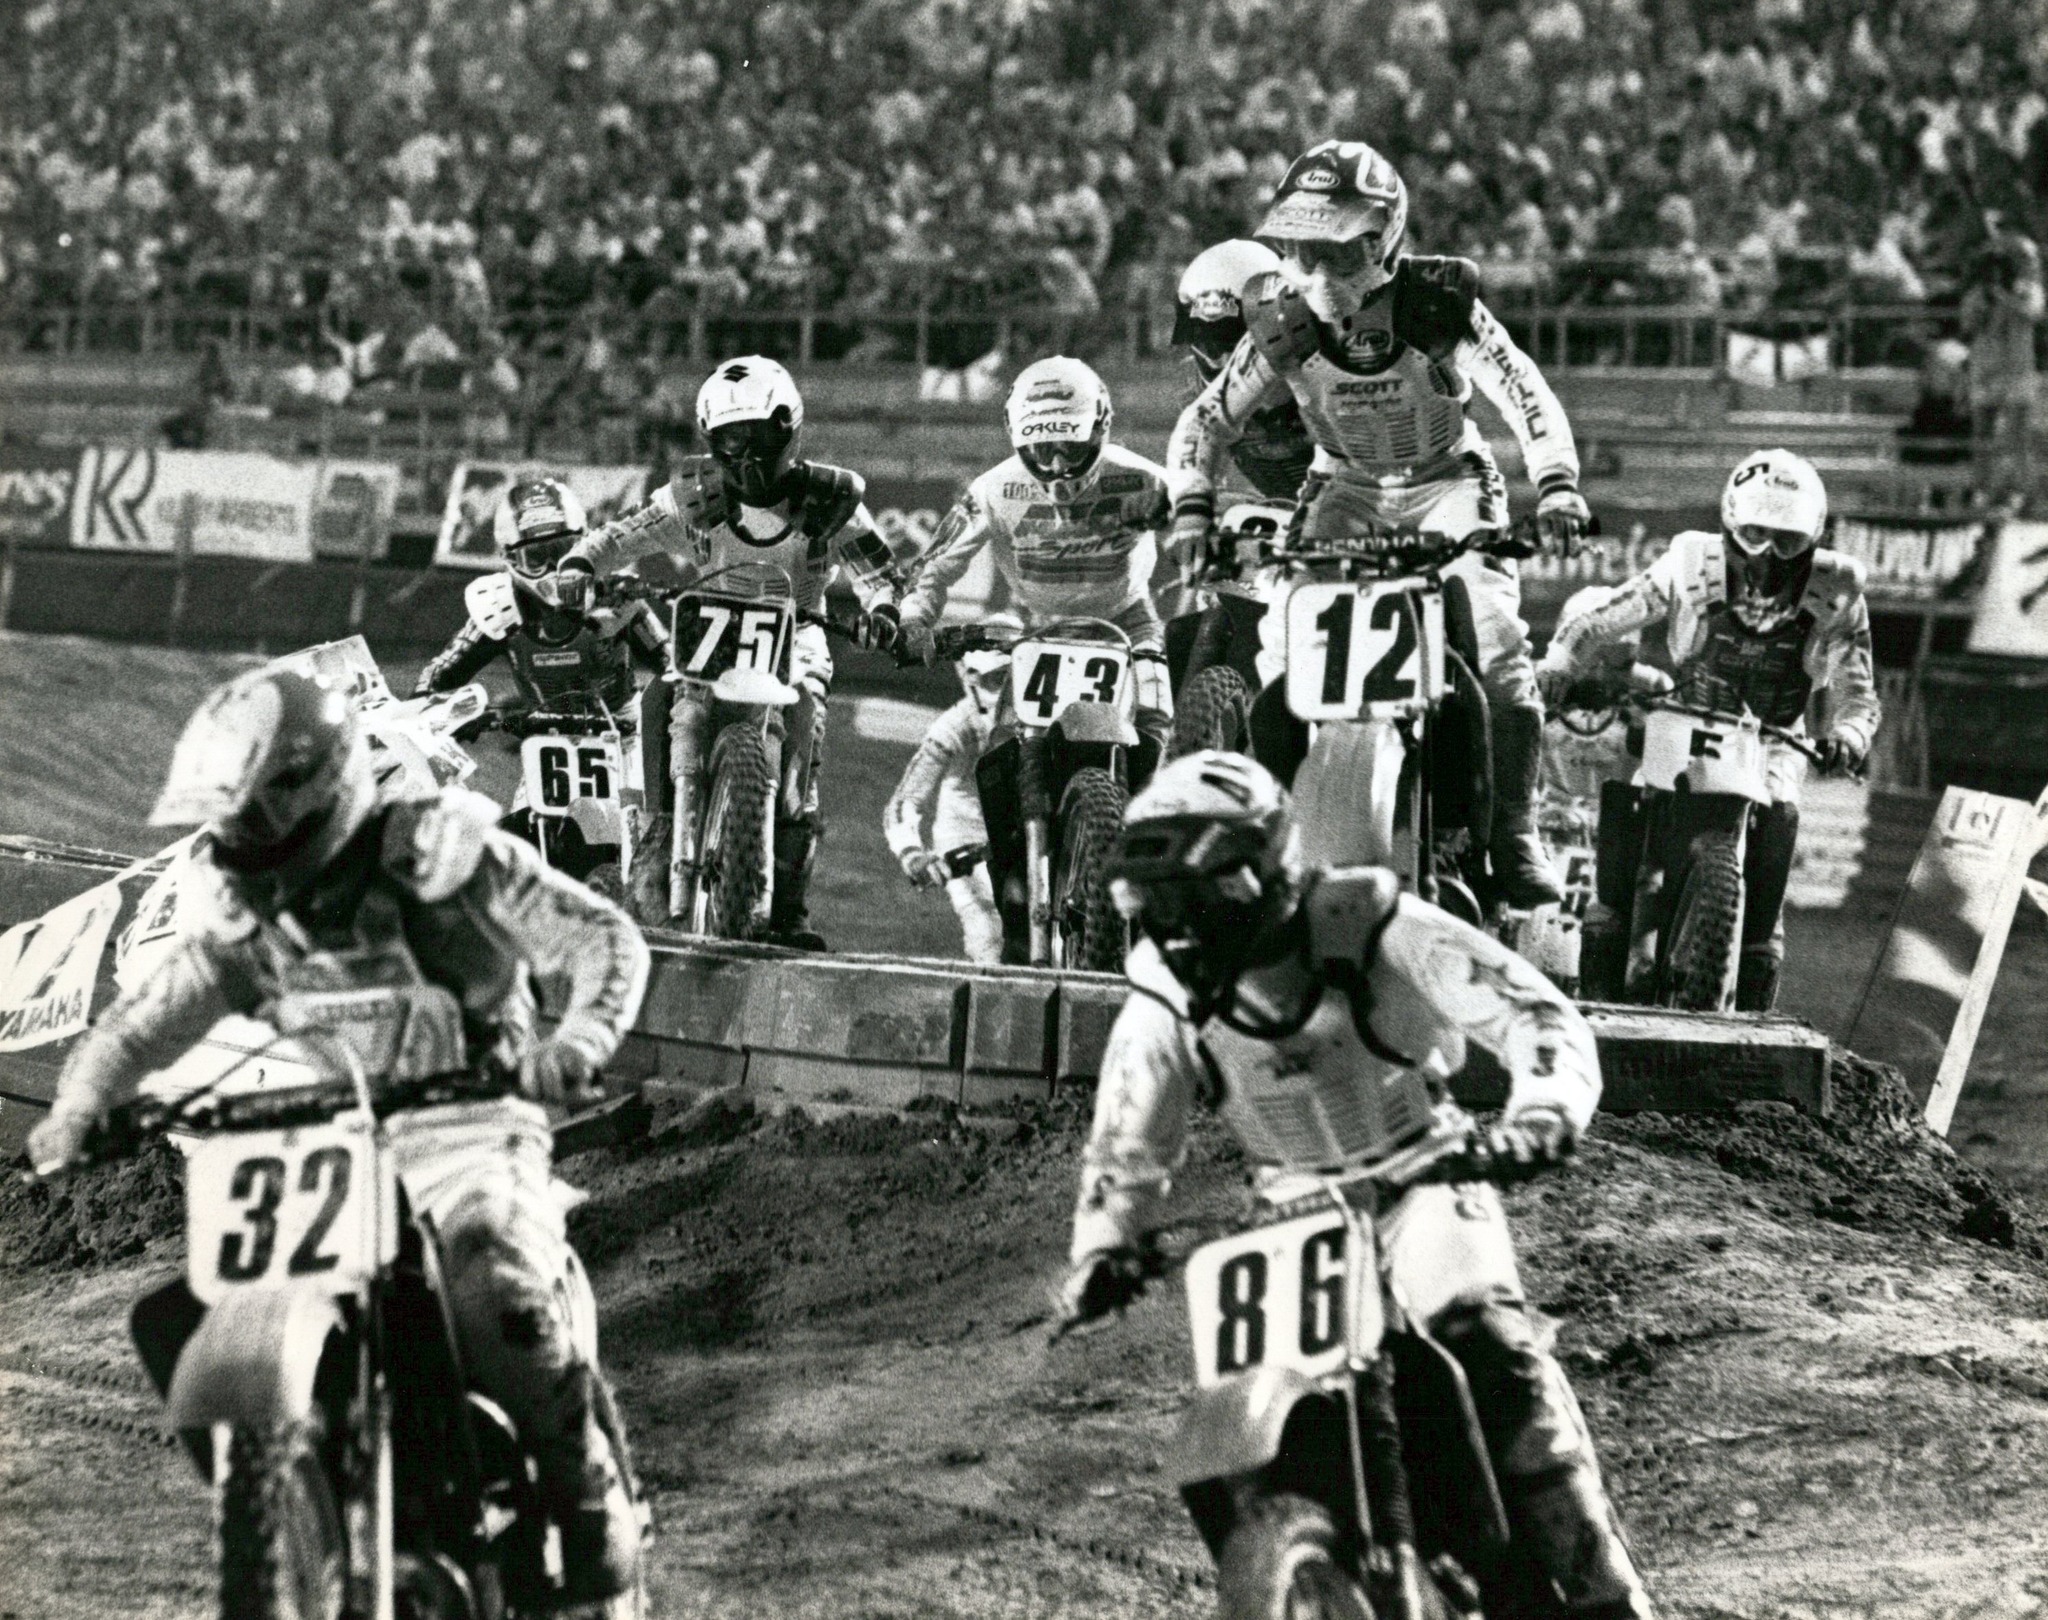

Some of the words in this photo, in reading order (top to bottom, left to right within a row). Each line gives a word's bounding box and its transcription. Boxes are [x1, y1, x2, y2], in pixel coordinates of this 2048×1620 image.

[1330, 378, 1403, 395] SCOTT
[1021, 421, 1080, 437] OAKLEY
[686, 606, 777, 673] 75
[1315, 592, 1418, 704] 12
[1023, 653, 1120, 718] 43
[539, 746, 610, 807] 65
[217, 1145, 353, 1283] 32
[1215, 1226, 1346, 1376] 86
